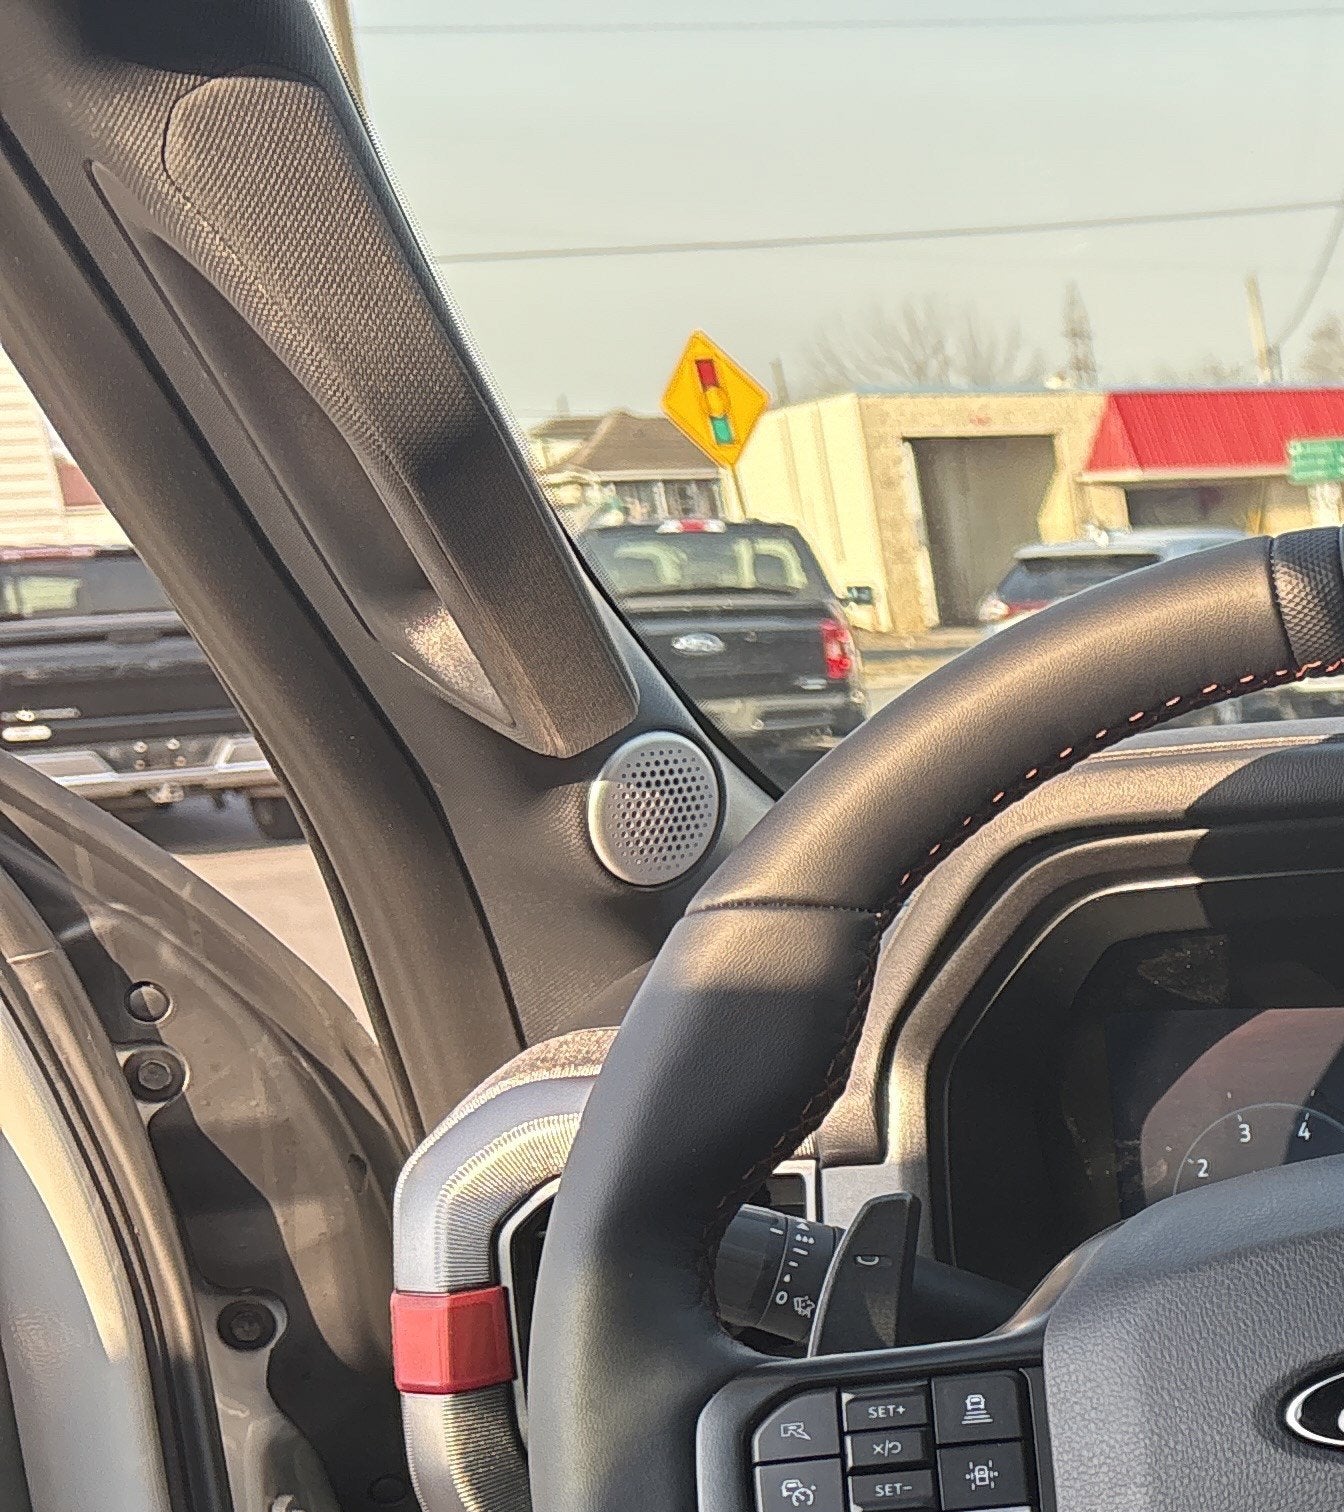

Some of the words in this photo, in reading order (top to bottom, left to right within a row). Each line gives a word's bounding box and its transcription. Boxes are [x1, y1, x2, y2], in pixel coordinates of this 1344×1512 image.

[1238, 1123, 1251, 1143] 3
[1298, 1121, 1311, 1140] 4
[1197, 1158, 1209, 1177] 2
